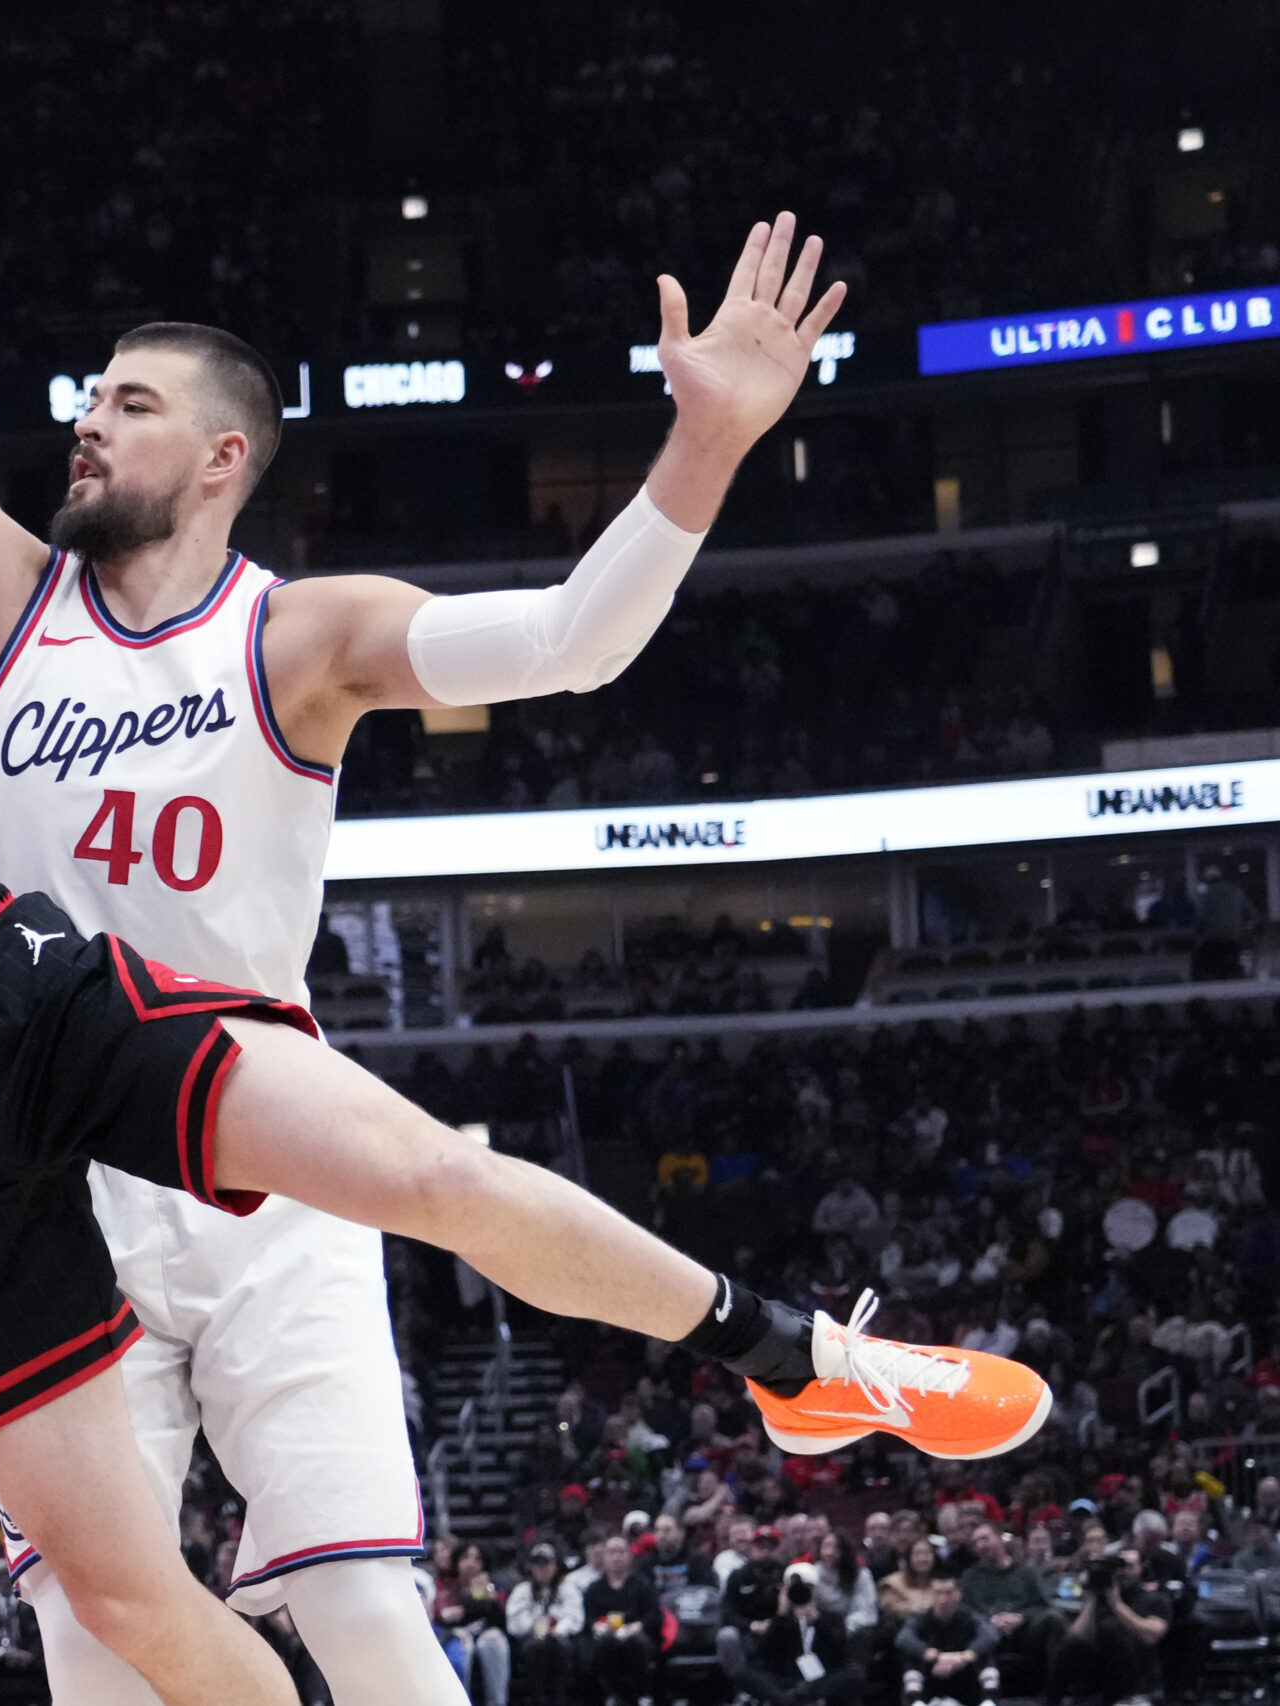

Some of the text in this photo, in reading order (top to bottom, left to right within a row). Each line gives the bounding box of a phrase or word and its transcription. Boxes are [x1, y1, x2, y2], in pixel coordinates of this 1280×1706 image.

[990, 296, 1274, 358] ULTRA CLUB
[0, 687, 237, 783] Clippers
[73, 788, 224, 893] 40
